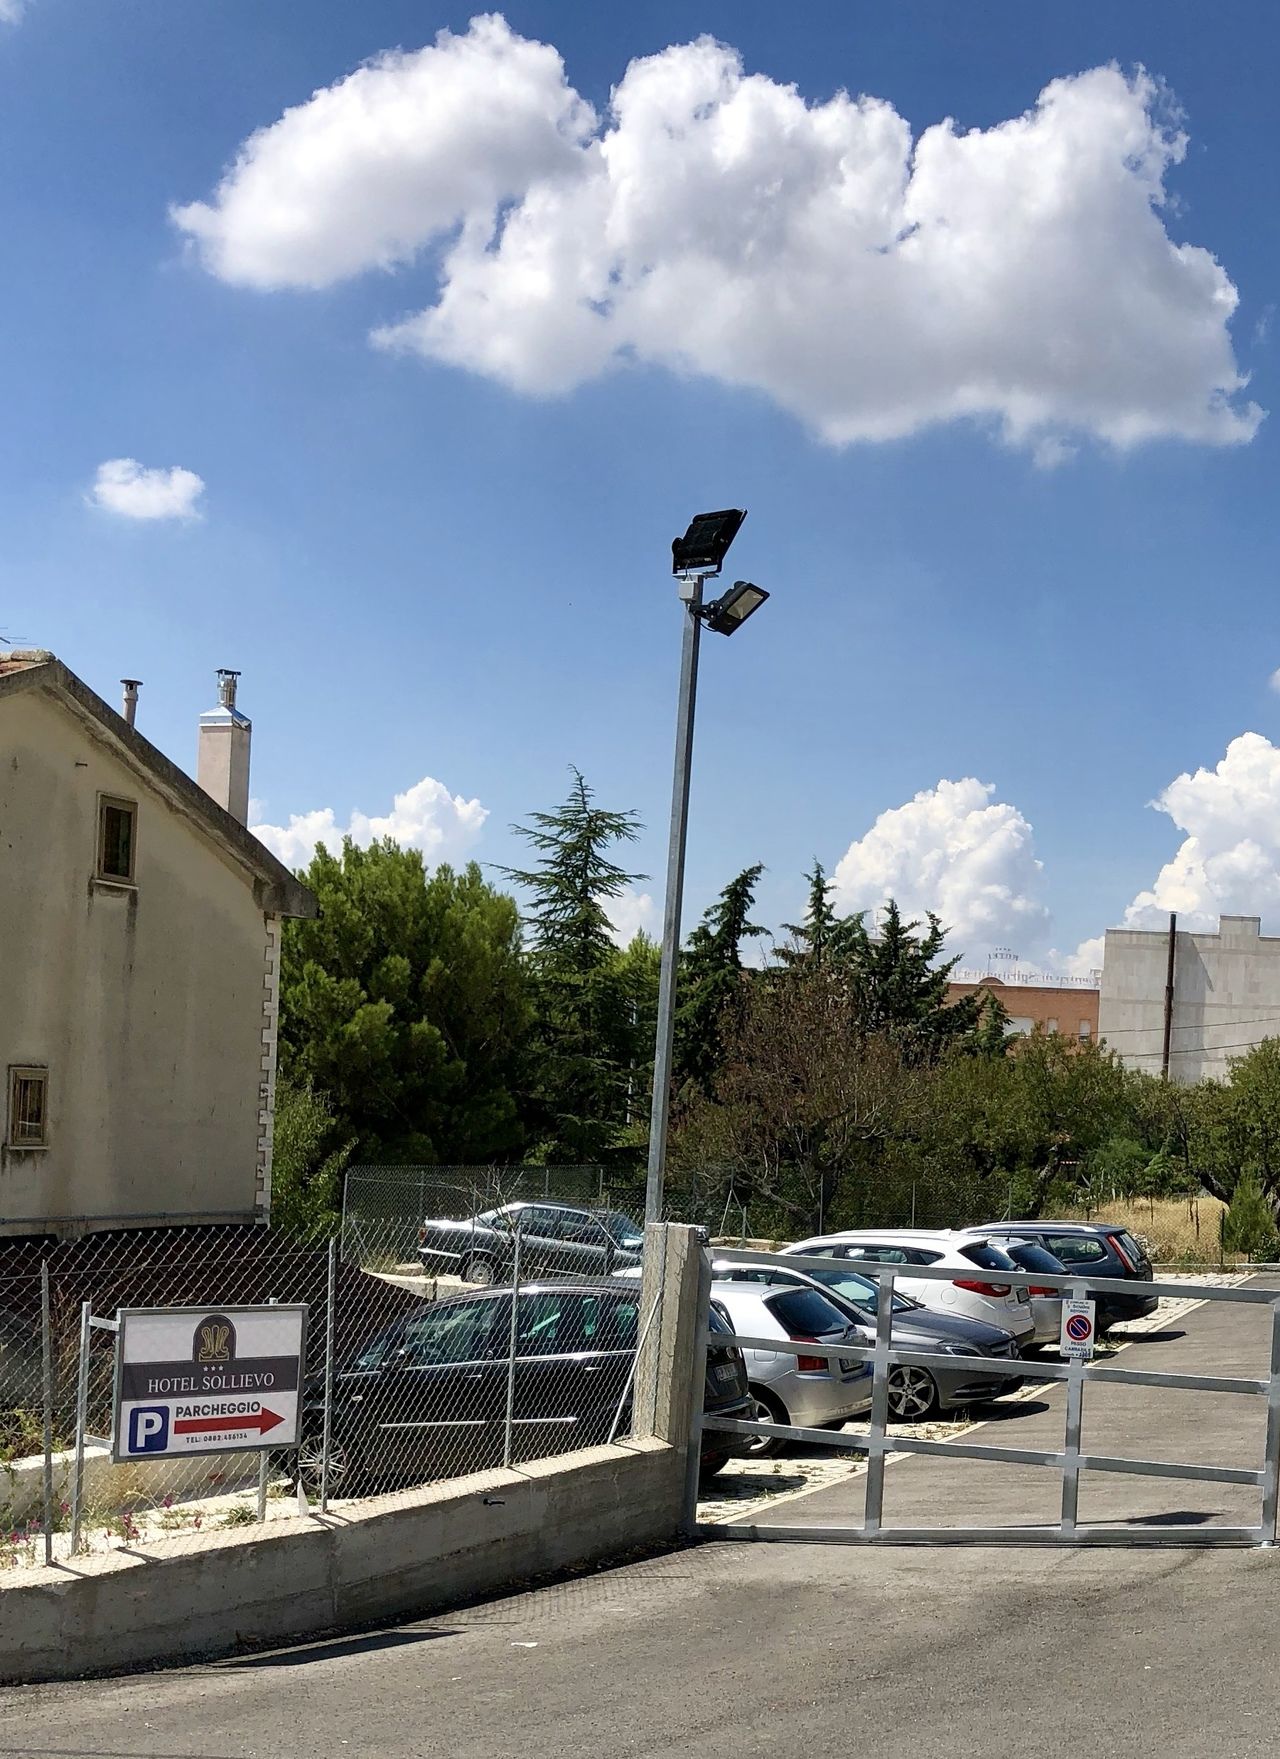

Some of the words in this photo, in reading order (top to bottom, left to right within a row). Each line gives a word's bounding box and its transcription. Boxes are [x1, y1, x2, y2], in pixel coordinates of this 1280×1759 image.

[148, 1377, 199, 1393] HOTEL
[202, 1372, 275, 1390] SOLLIEVO
[175, 1401, 261, 1418] PARCHEGGIO
[136, 1411, 163, 1448] P
